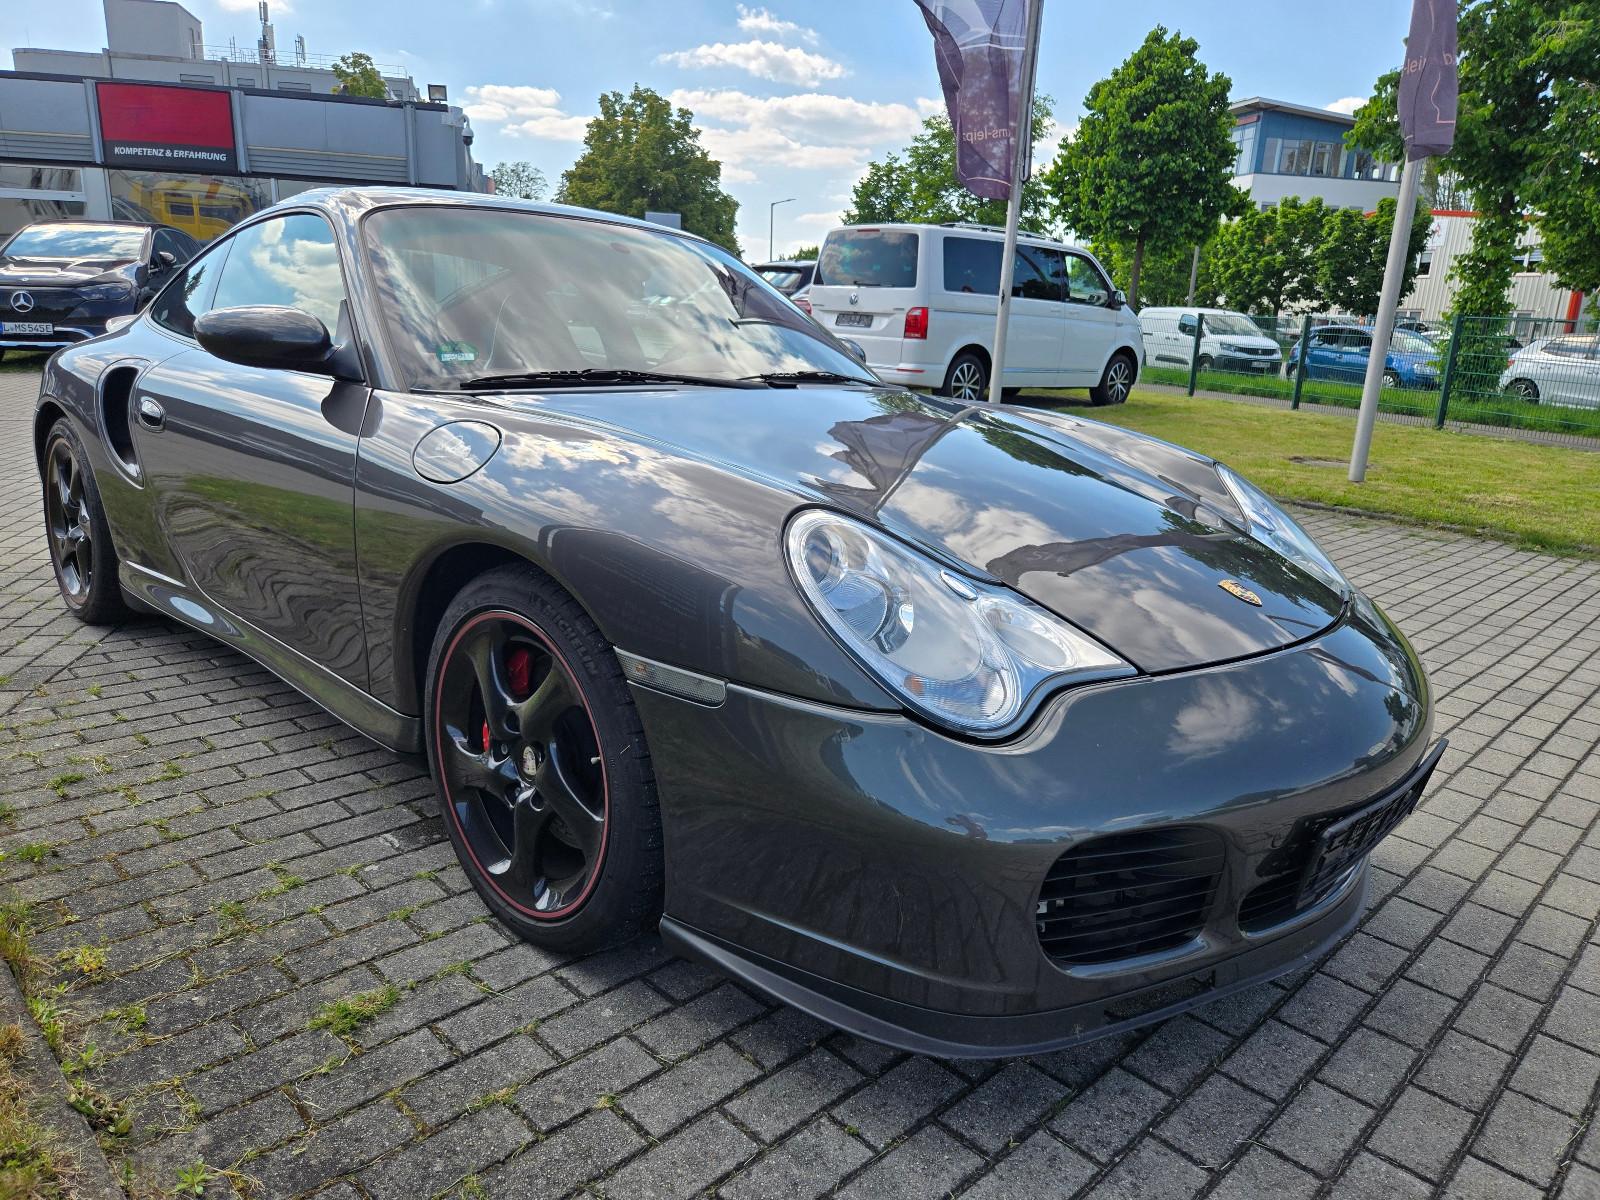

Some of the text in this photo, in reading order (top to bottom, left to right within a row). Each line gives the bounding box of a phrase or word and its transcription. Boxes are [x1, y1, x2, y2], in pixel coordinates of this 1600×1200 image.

[114, 146, 227, 161] KOMPETENZ & ERFAHRUNG
